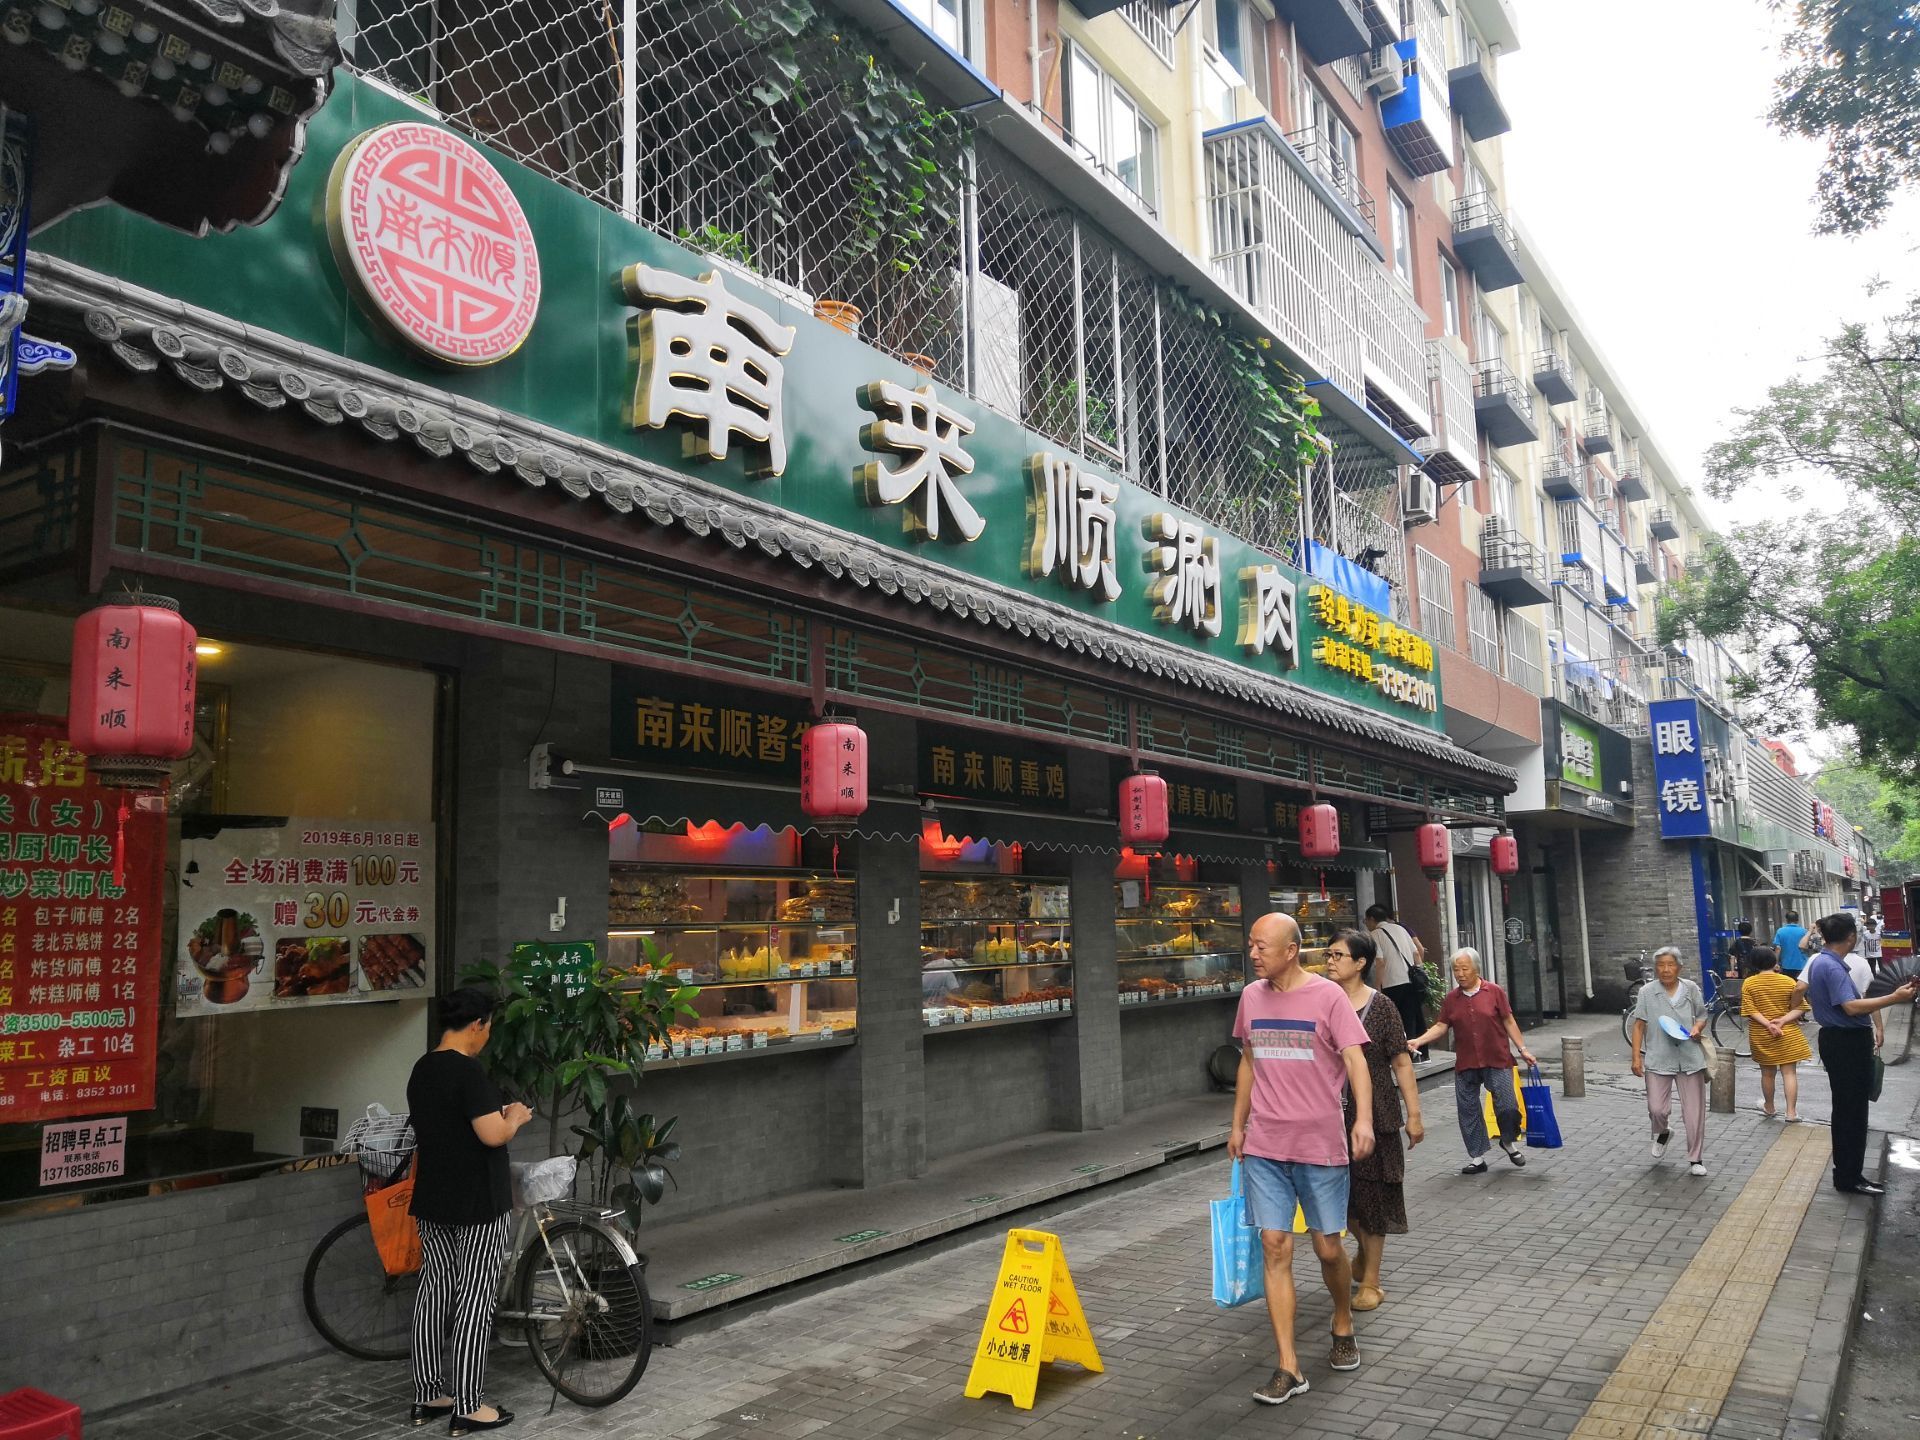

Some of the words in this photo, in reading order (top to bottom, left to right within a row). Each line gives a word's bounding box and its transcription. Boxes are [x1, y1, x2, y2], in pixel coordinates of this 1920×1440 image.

[622, 262, 1299, 670] 南来顺涮肉
[99, 627, 132, 730] 南来顺
[840, 737, 856, 800] 南来顺
[931, 745, 1065, 800] 南来顺熏鸡
[1655, 719, 1703, 814] 眼镜
[302, 831, 420, 847] 2019年6月18日起
[224, 855, 420, 886] 全场消费满100元
[2, 906, 17, 927] 名
[34, 906, 105, 926] 包子师傅
[113, 906, 140, 926] 2名
[0, 933, 16, 953] 名
[32, 932, 103, 952] 老北京烧饼
[112, 932, 138, 950] 2名
[30, 957, 102, 978] 炸货师傅
[111, 956, 137, 976] 2名
[29, 982, 101, 1005] 炸糕师傅
[112, 981, 136, 1000] 1名
[103, 1032, 135, 1054] 10名
[25, 1065, 112, 1088] 工资面议
[76, 1087, 105, 1099] 8352
[109, 1083, 136, 1096] 3011
[45, 1126, 123, 1154] 招聘早点工
[63, 1151, 101, 1164] 联系电话
[42, 1159, 120, 1182] 13718588676
[1003, 1280, 1018, 1290] WET
[1019, 1283, 1042, 1294] FLOOR
[1008, 1273, 1040, 1286] CAUTION
[987, 1337, 1031, 1363] 小心地滑
